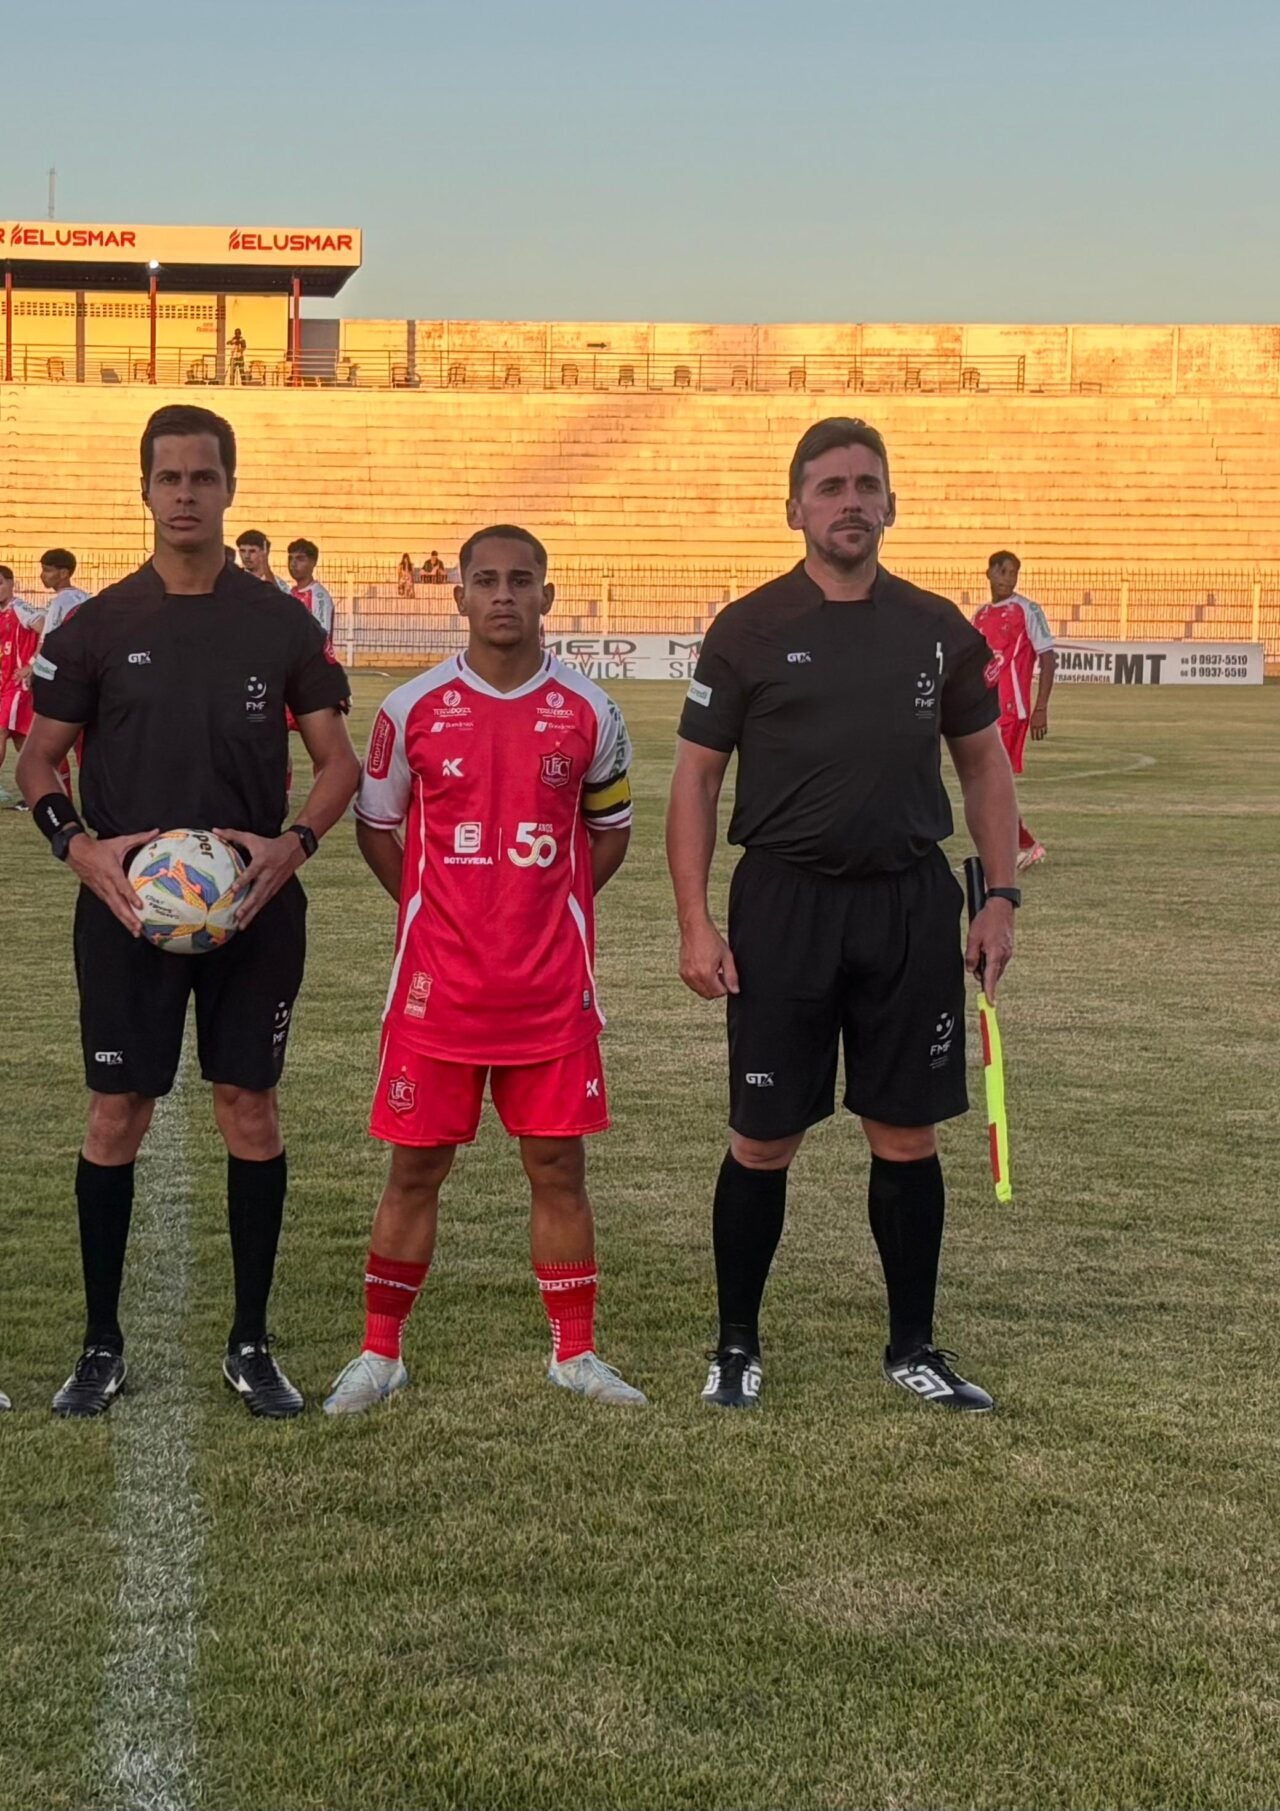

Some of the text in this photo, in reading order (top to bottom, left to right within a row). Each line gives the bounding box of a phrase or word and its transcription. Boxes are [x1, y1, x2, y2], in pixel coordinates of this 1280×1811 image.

[23, 229, 136, 247] ELUSMAR
[241, 234, 353, 250] ELUSMAR
[128, 651, 151, 665] GTX
[1114, 654, 1166, 684] MT
[246, 701, 266, 711] FMF
[915, 698, 935, 708] FMF
[507, 822, 557, 868] 50
[273, 1032, 286, 1045] MF
[930, 1040, 952, 1057] FMF
[95, 1050, 123, 1065] GTX
[745, 1072, 774, 1087] GTX
